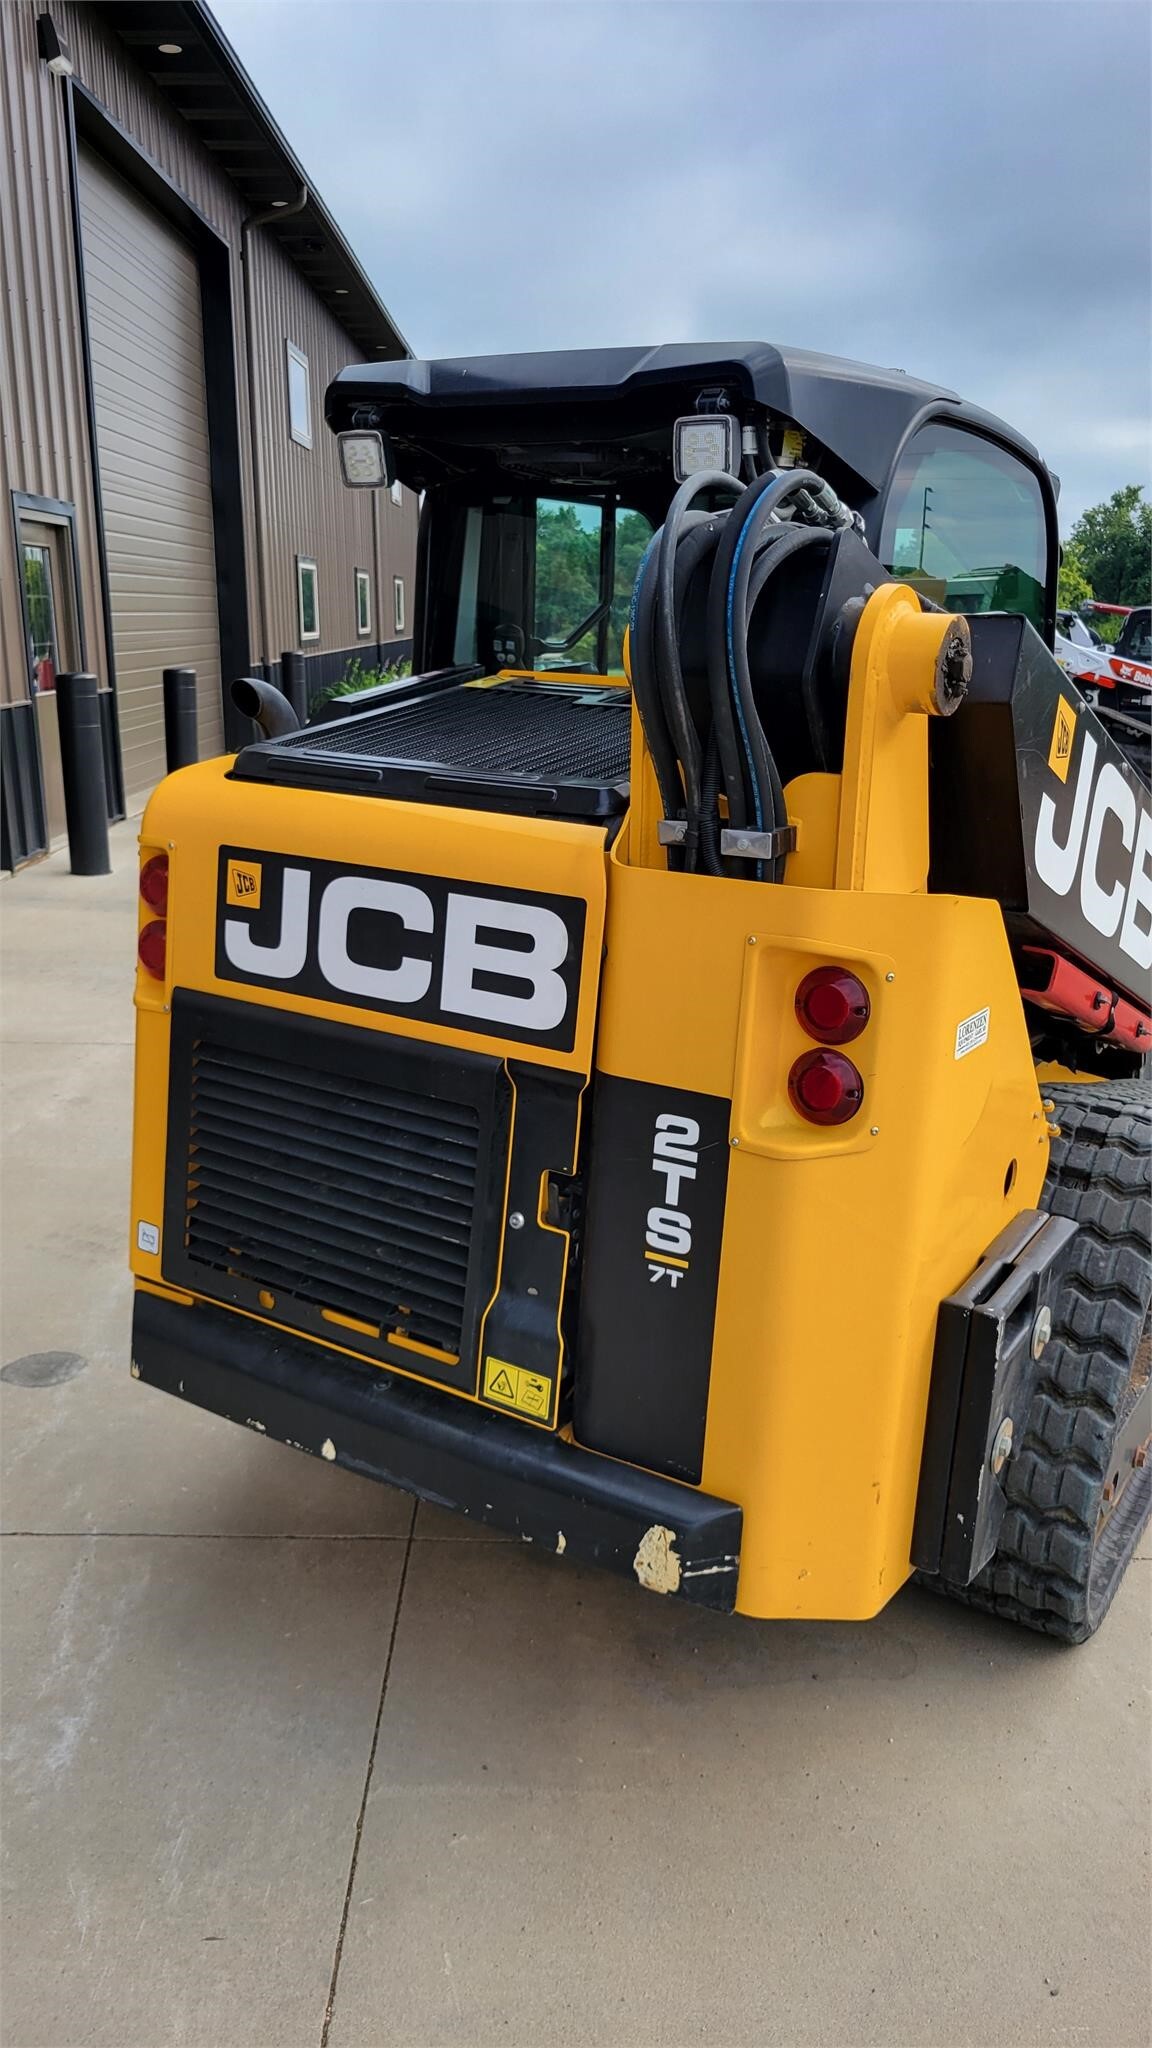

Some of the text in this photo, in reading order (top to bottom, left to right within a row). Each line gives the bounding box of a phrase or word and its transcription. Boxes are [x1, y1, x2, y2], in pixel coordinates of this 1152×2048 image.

[236, 871, 255, 894] JCB
[224, 867, 568, 1030] JCB
[645, 1113, 700, 1255] 2TS
[647, 1263, 684, 1289] 7T
